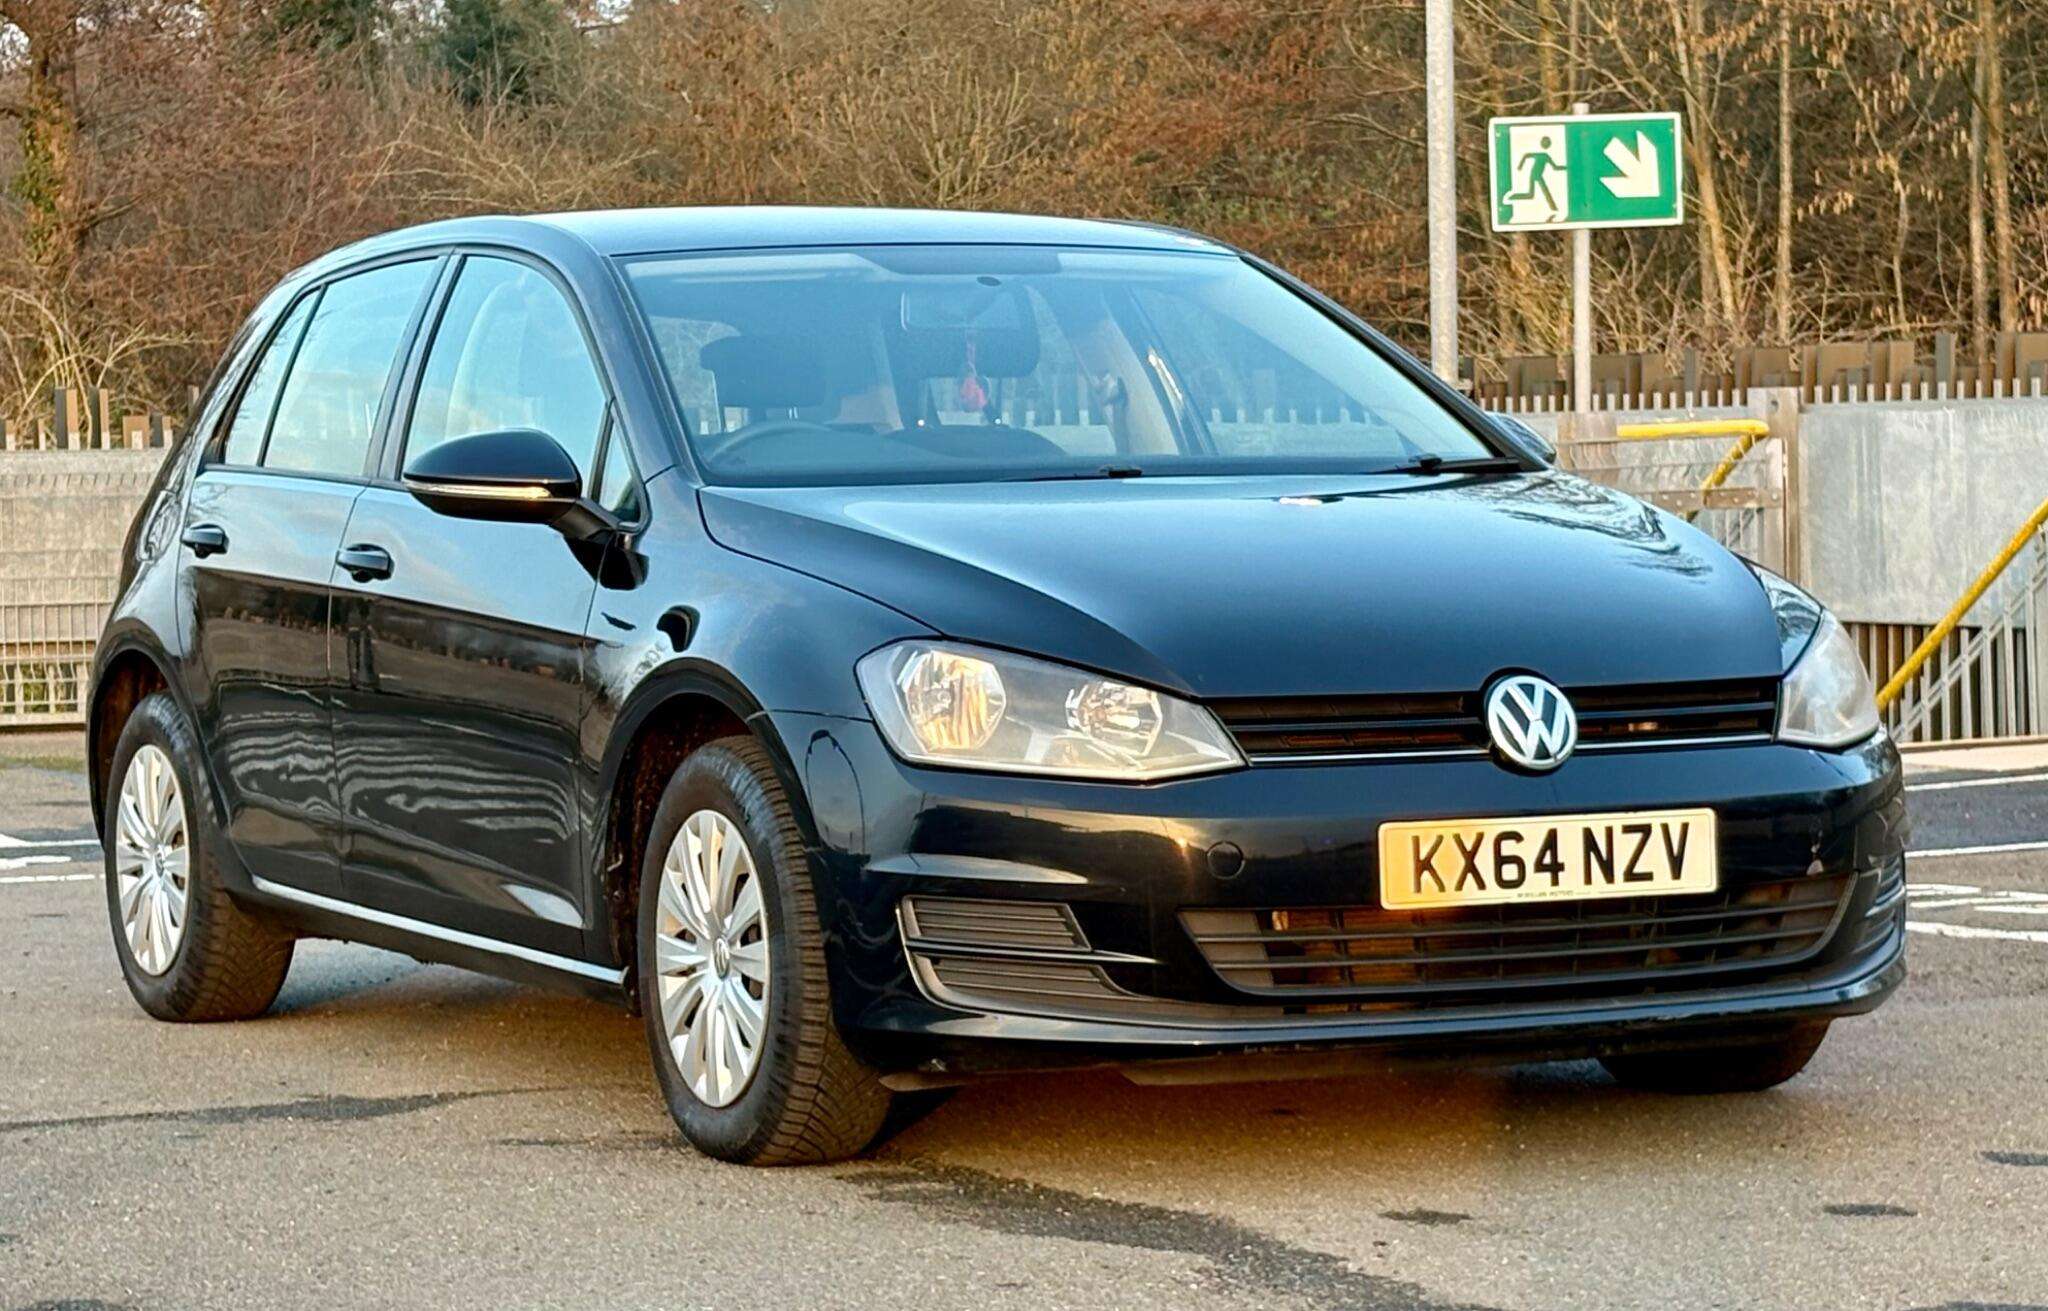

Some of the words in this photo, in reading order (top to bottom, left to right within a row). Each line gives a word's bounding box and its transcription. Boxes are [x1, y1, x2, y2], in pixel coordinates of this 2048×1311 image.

[1489, 676, 1576, 768] VW
[1412, 827, 1565, 894] KX64
[1583, 822, 1690, 886] NZV
